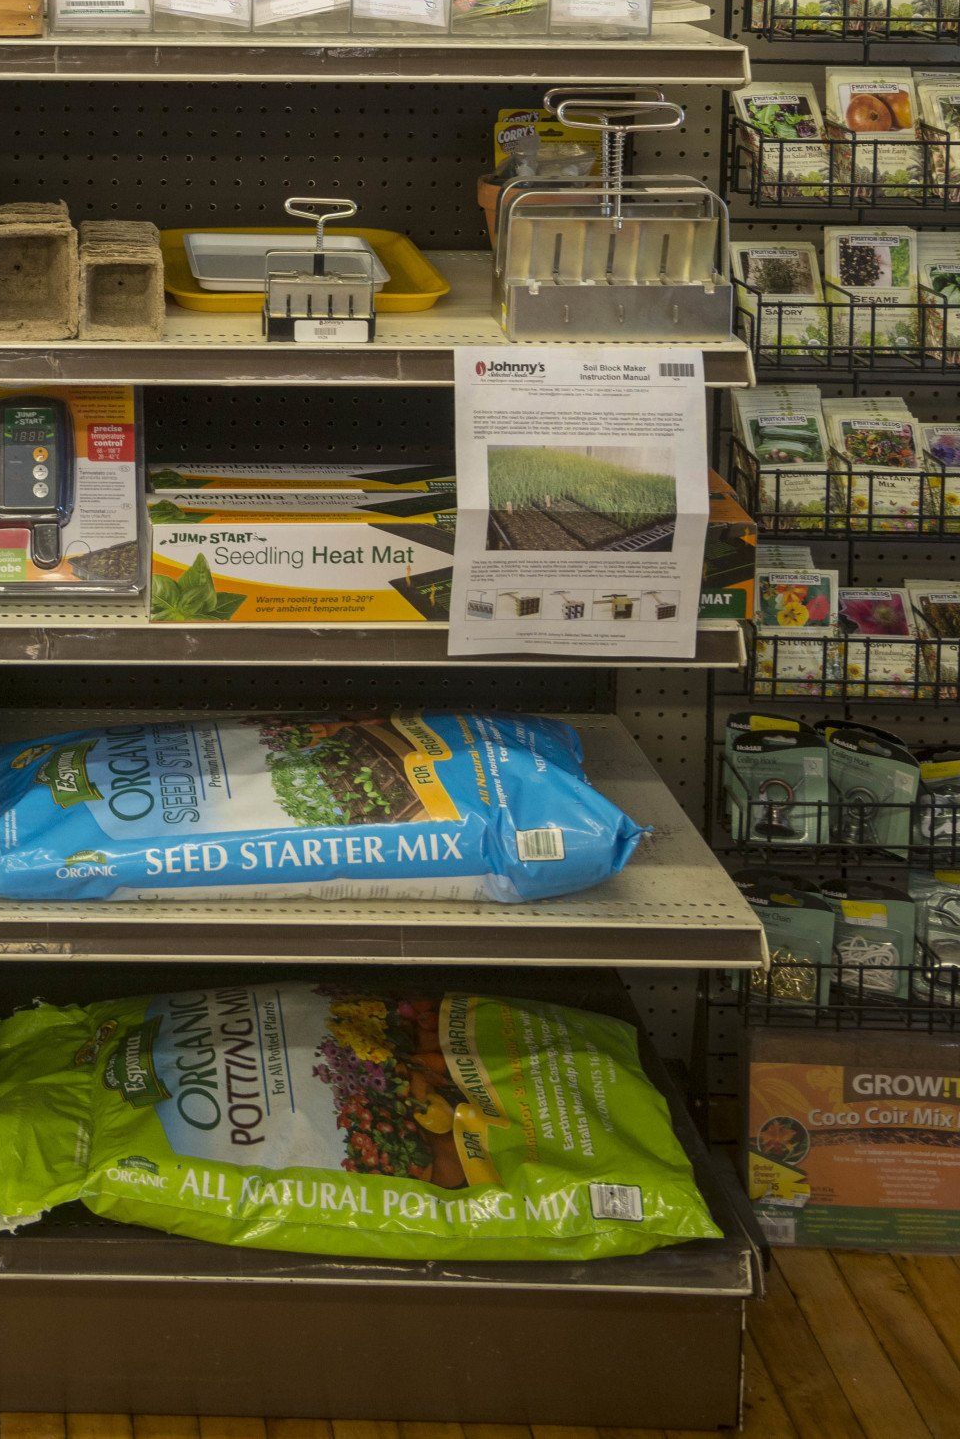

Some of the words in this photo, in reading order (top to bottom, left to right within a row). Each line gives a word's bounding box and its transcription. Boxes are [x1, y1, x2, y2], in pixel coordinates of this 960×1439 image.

[498, 125, 535, 144] CORRY'S
[852, 295, 899, 303] SESAME
[487, 361, 545, 375] Johnny's
[580, 373, 621, 381] Instruction
[215, 547, 304, 568] Seedling
[312, 546, 363, 563] Heat
[372, 546, 414, 563] Mat
[701, 594, 732, 605] MAT
[146, 843, 227, 876] SEED
[241, 836, 383, 871] STARTER
[397, 833, 463, 862] MIX
[56, 865, 117, 879] ORGANIC
[264, 1002, 276, 1029] Plants
[268, 1030, 280, 1061] Potted
[169, 994, 222, 1131] ORGANIC
[271, 1064, 284, 1078] All
[273, 1079, 285, 1095] For
[809, 1108, 860, 1126] Coco
[865, 1107, 908, 1124] Coir
[913, 1107, 952, 1128] Mix
[180, 1168, 231, 1201] ALL
[240, 1176, 373, 1214] NATURAL
[383, 1189, 515, 1224] POTTING
[524, 1189, 578, 1221] MIX
